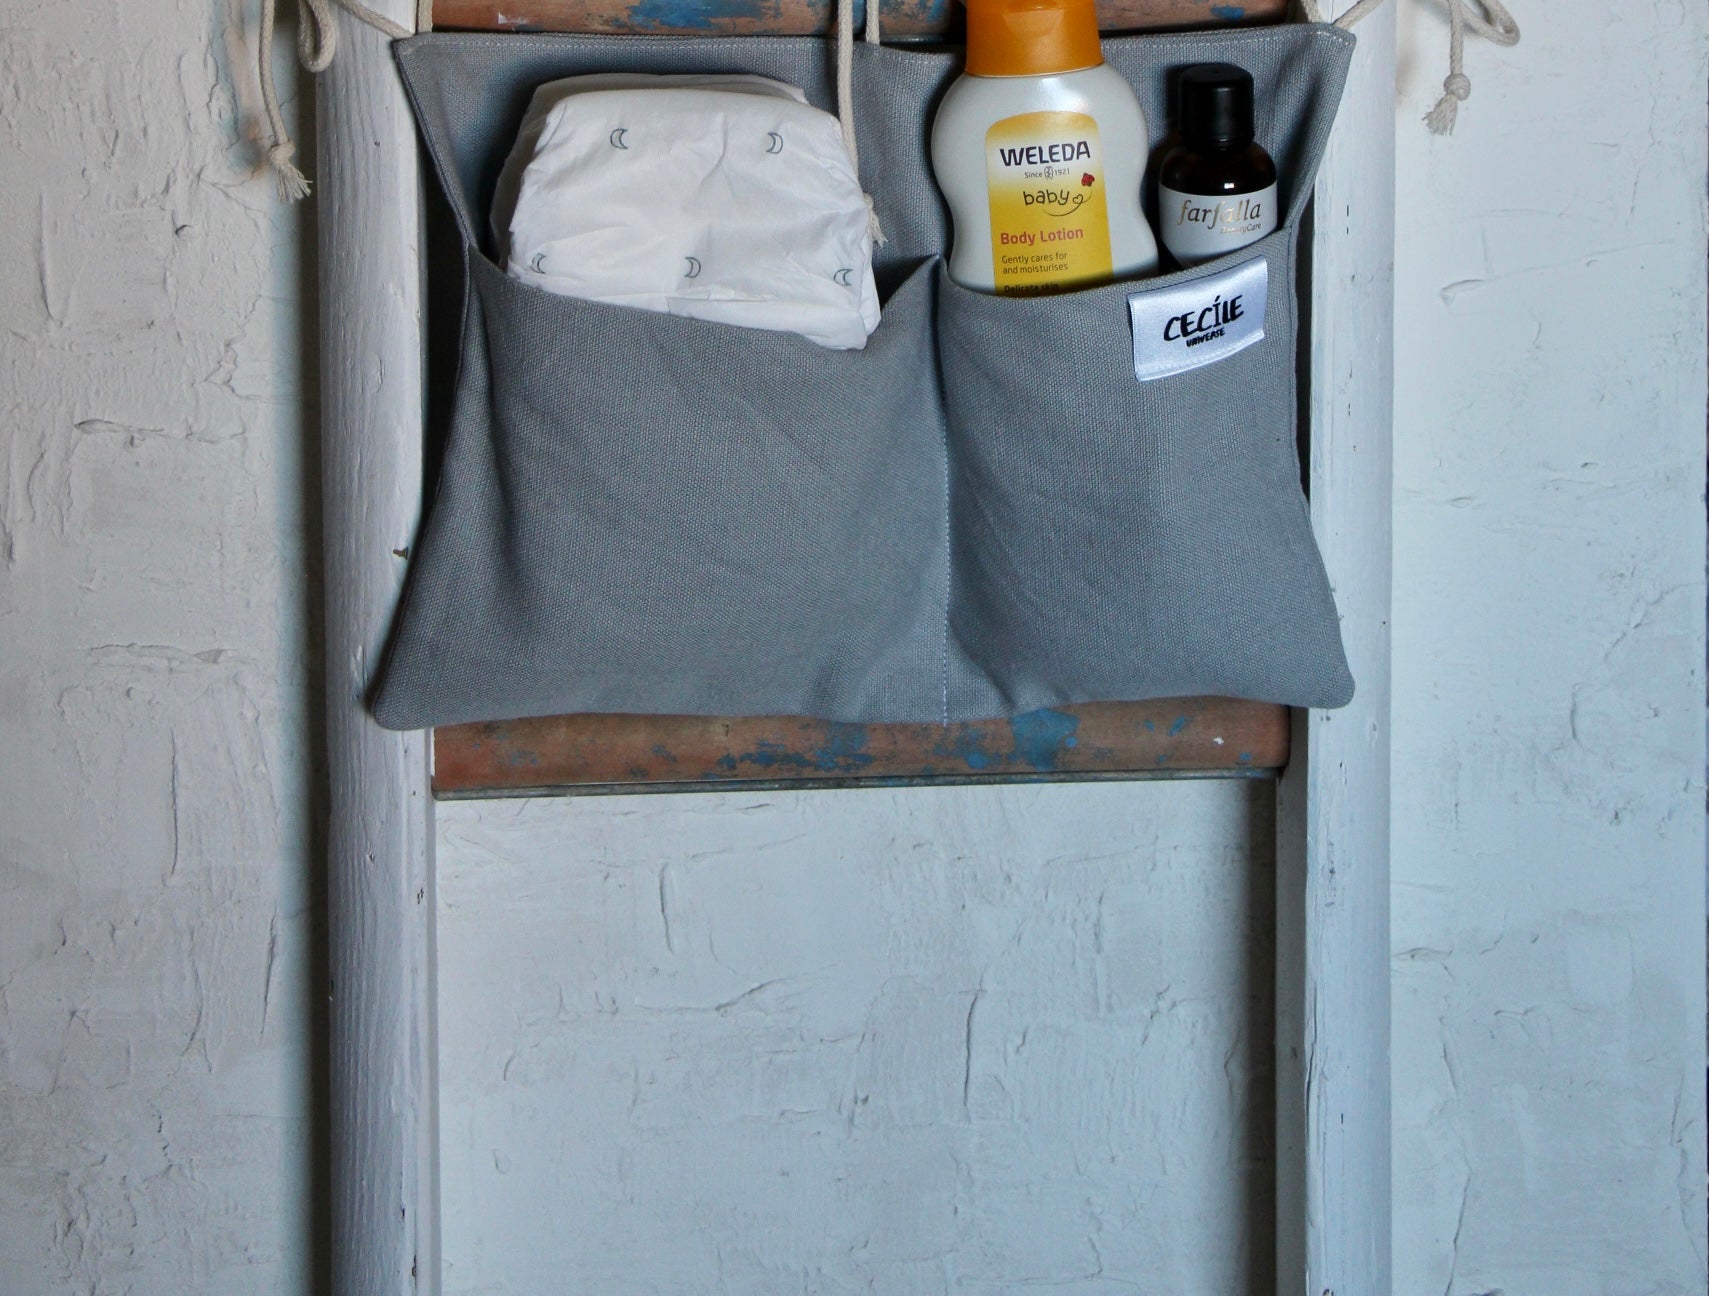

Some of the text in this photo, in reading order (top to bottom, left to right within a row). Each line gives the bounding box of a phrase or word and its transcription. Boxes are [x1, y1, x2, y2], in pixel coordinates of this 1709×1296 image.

[1000, 141, 1090, 166] WELEDA
[1025, 168, 1070, 179] Since 1921
[1023, 189, 1069, 206] baby
[1177, 199, 1261, 230] farfalla
[1000, 228, 1084, 246] Body Lotion
[1001, 252, 1067, 265] Gently cares for
[1002, 263, 1068, 274] and moisturises
